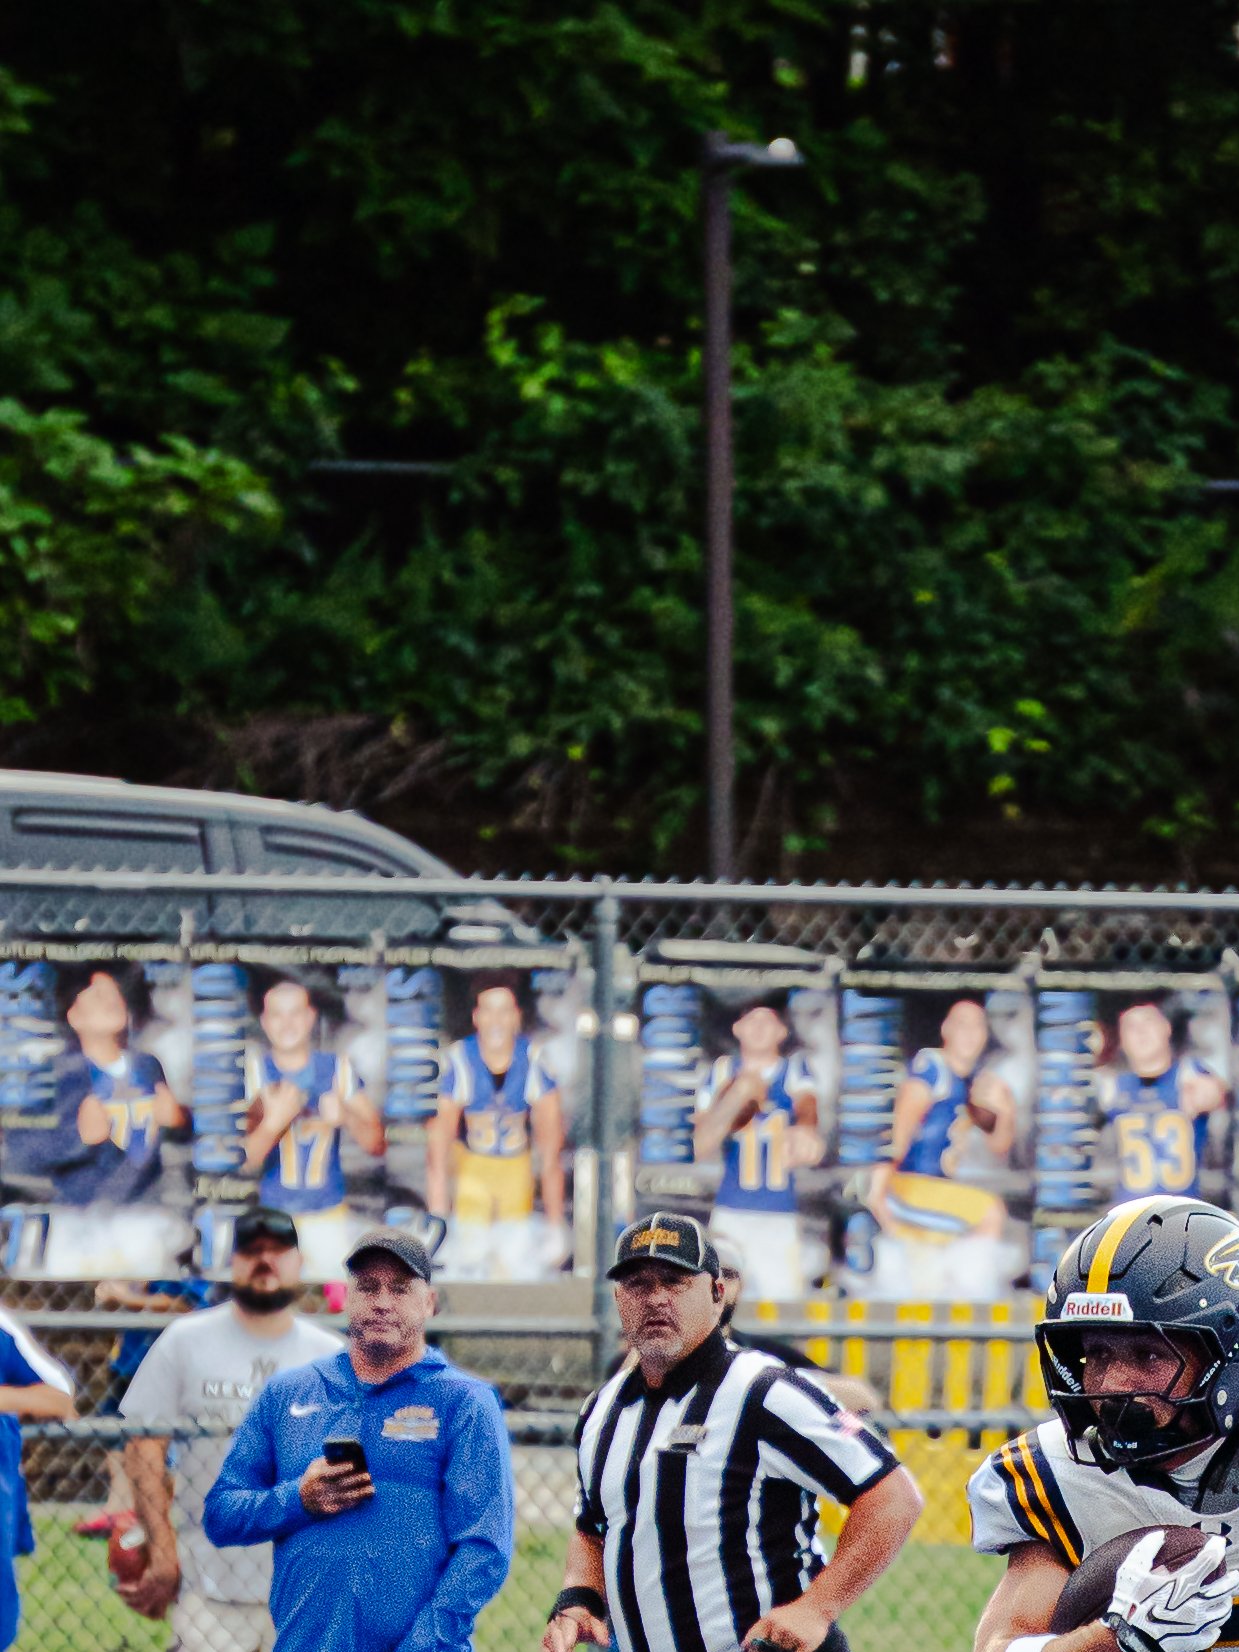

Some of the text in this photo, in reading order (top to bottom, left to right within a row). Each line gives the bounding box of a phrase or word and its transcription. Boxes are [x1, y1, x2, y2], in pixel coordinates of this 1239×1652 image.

[384, 968, 441, 1116] ROJAS
[278, 1120, 337, 1190] 17
[735, 1109, 790, 1191] 11
[1114, 1108, 1196, 1193] 53
[1066, 1302, 1122, 1317] Riddell
[202, 1380, 254, 1400] NEW
